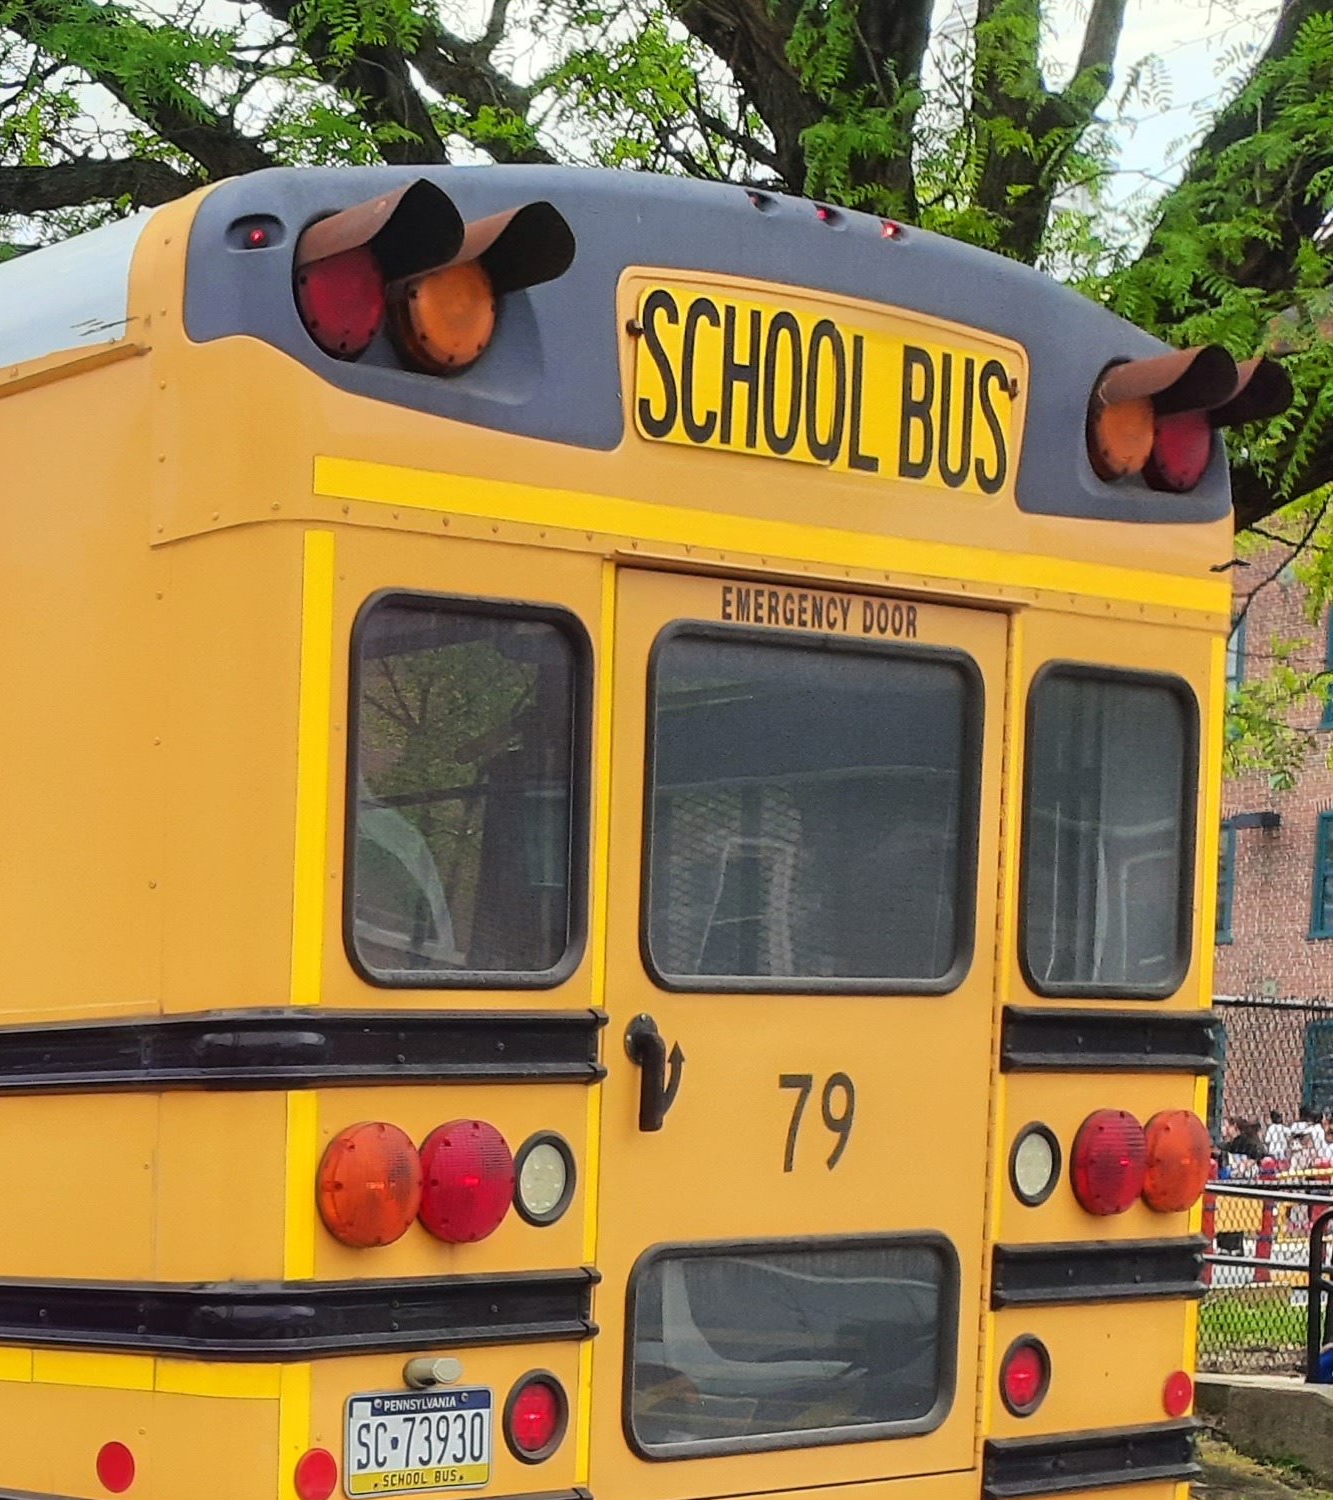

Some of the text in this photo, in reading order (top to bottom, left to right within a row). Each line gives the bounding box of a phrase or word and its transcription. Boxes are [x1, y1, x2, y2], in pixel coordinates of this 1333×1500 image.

[638, 289, 1009, 494] SCHOOL BUS
[721, 585, 918, 638] EMERGENCY DOOR
[778, 1071, 855, 1173] 79
[384, 1395, 457, 1412] PENNSYLVANIA
[383, 1468, 458, 1488] SCHOOL BUS
